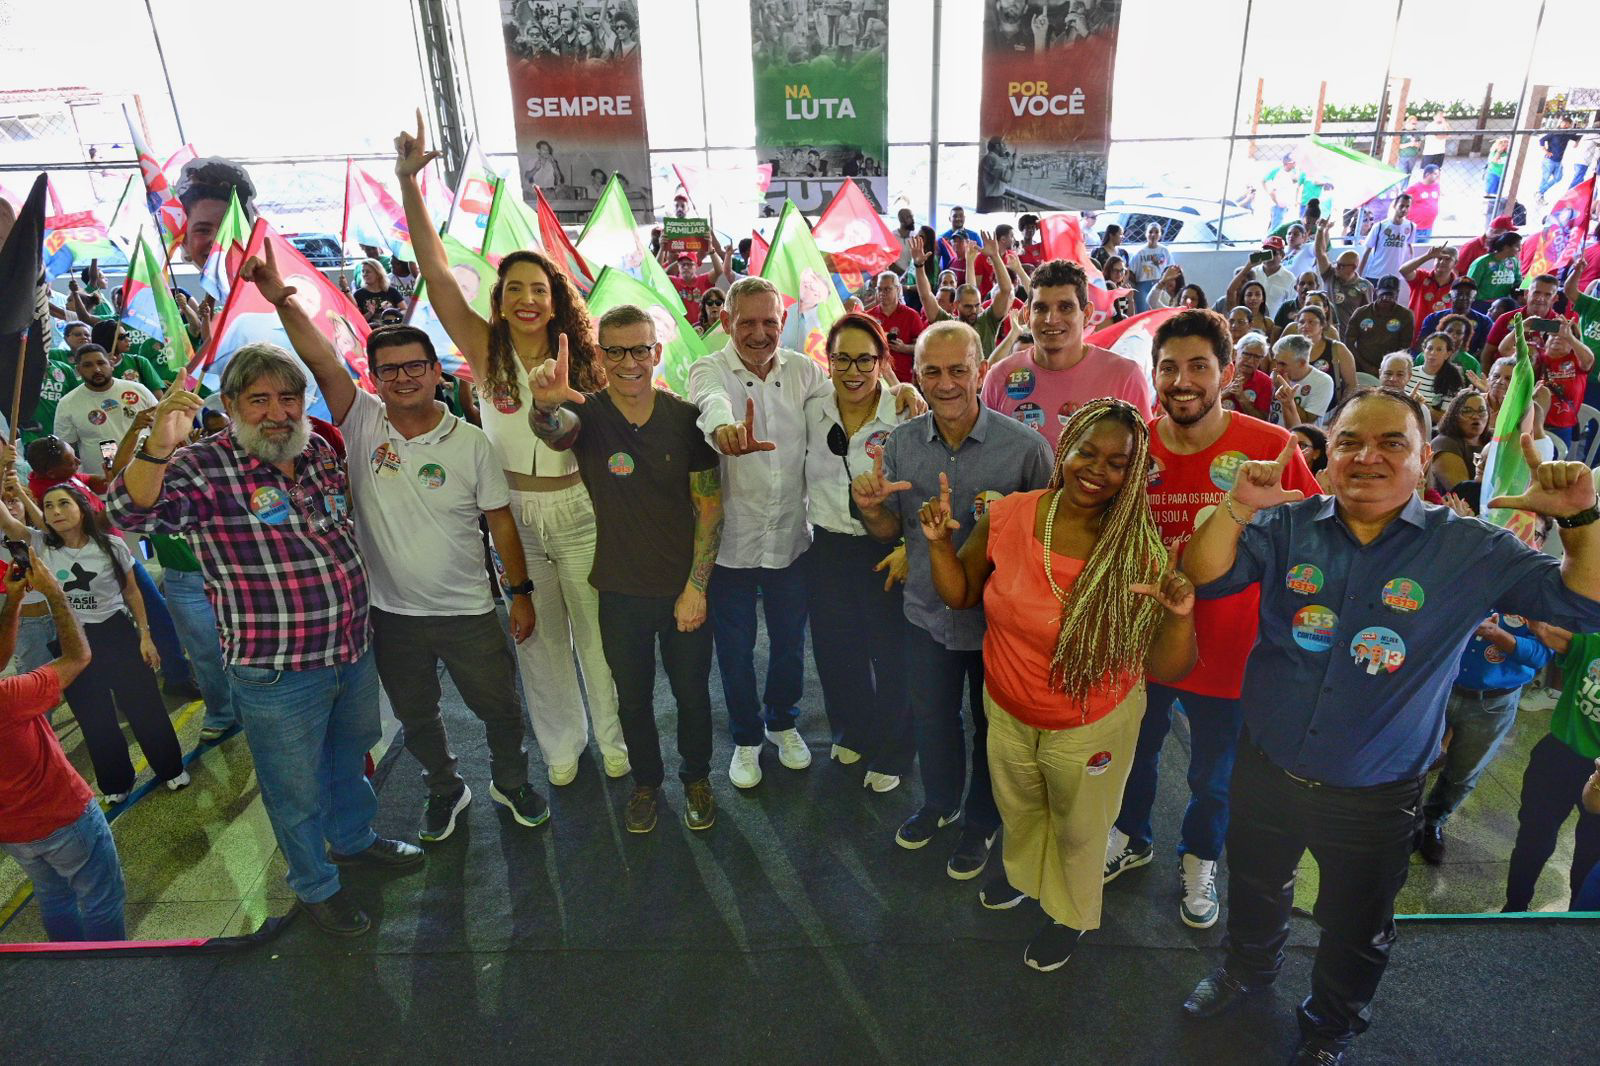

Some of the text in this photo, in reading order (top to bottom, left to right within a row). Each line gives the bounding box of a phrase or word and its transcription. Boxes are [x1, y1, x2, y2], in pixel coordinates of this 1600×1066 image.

[785, 84, 812, 98] NA
[1008, 80, 1049, 97] POR
[526, 95, 633, 118] SEMPRE
[785, 97, 857, 120] LUTA
[1008, 87, 1086, 117] VOCÊ
[665, 226, 706, 235] FAMILIAR
[1009, 371, 1030, 383] 133
[1161, 491, 1168, 505] É
[1167, 493, 1188, 505] PARA
[1188, 492, 1200, 504] OS
[1161, 510, 1180, 523] SOU
[1181, 509, 1189, 522] A
[67, 595, 98, 604] RASIL
[1299, 611, 1334, 628] 133
[1385, 648, 1402, 666] 13
